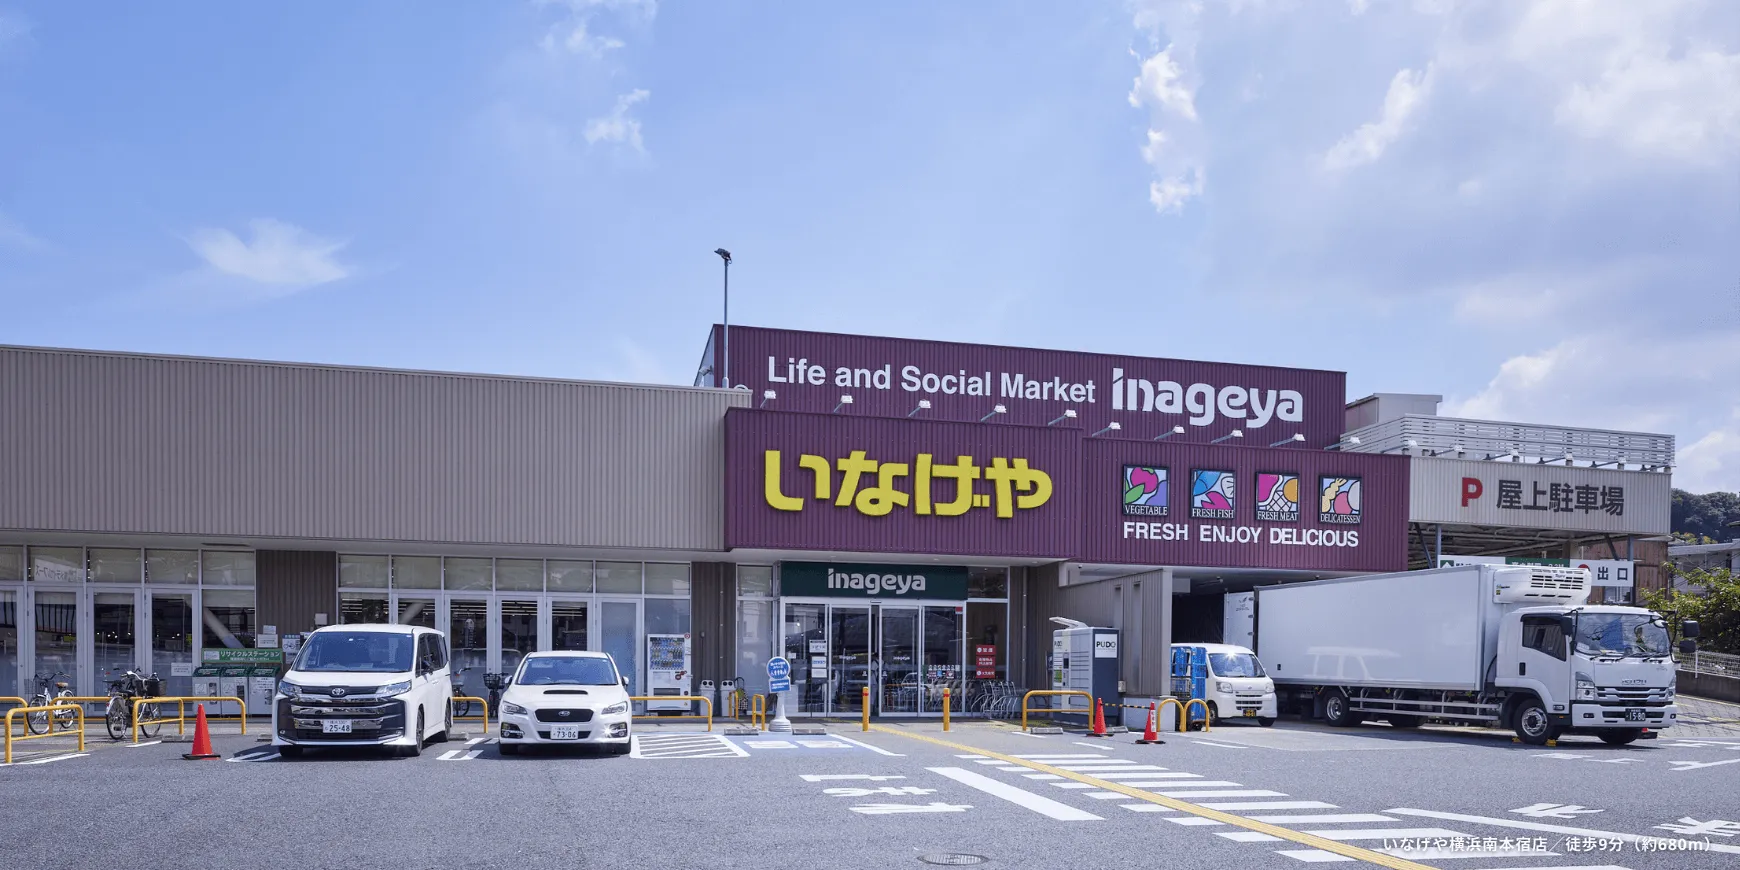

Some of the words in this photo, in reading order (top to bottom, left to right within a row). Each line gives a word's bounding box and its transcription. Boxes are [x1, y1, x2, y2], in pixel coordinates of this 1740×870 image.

[768, 356, 825, 386] Life
[835, 364, 891, 391] and
[901, 366, 991, 397] Social
[1001, 372, 1096, 404] Market
[1113, 368, 1303, 428] inageya
[765, 450, 1052, 518] いなげや
[1461, 477, 1483, 508] P
[1496, 480, 1625, 517] 屋上駐車場
[1125, 505, 1168, 516] VEGETABLE
[1192, 508, 1215, 518] FRESH
[1217, 510, 1234, 519] FISH
[1257, 511, 1279, 521] FRESH
[1280, 512, 1299, 521] MEAT
[1320, 513, 1361, 524] DELICATESSEN
[1123, 522, 1189, 541] FRESH
[1200, 524, 1262, 544] ENJOY
[1269, 528, 1359, 548] DELICIOUS
[827, 568, 926, 595] inageya
[1597, 566, 1628, 581] 出口
